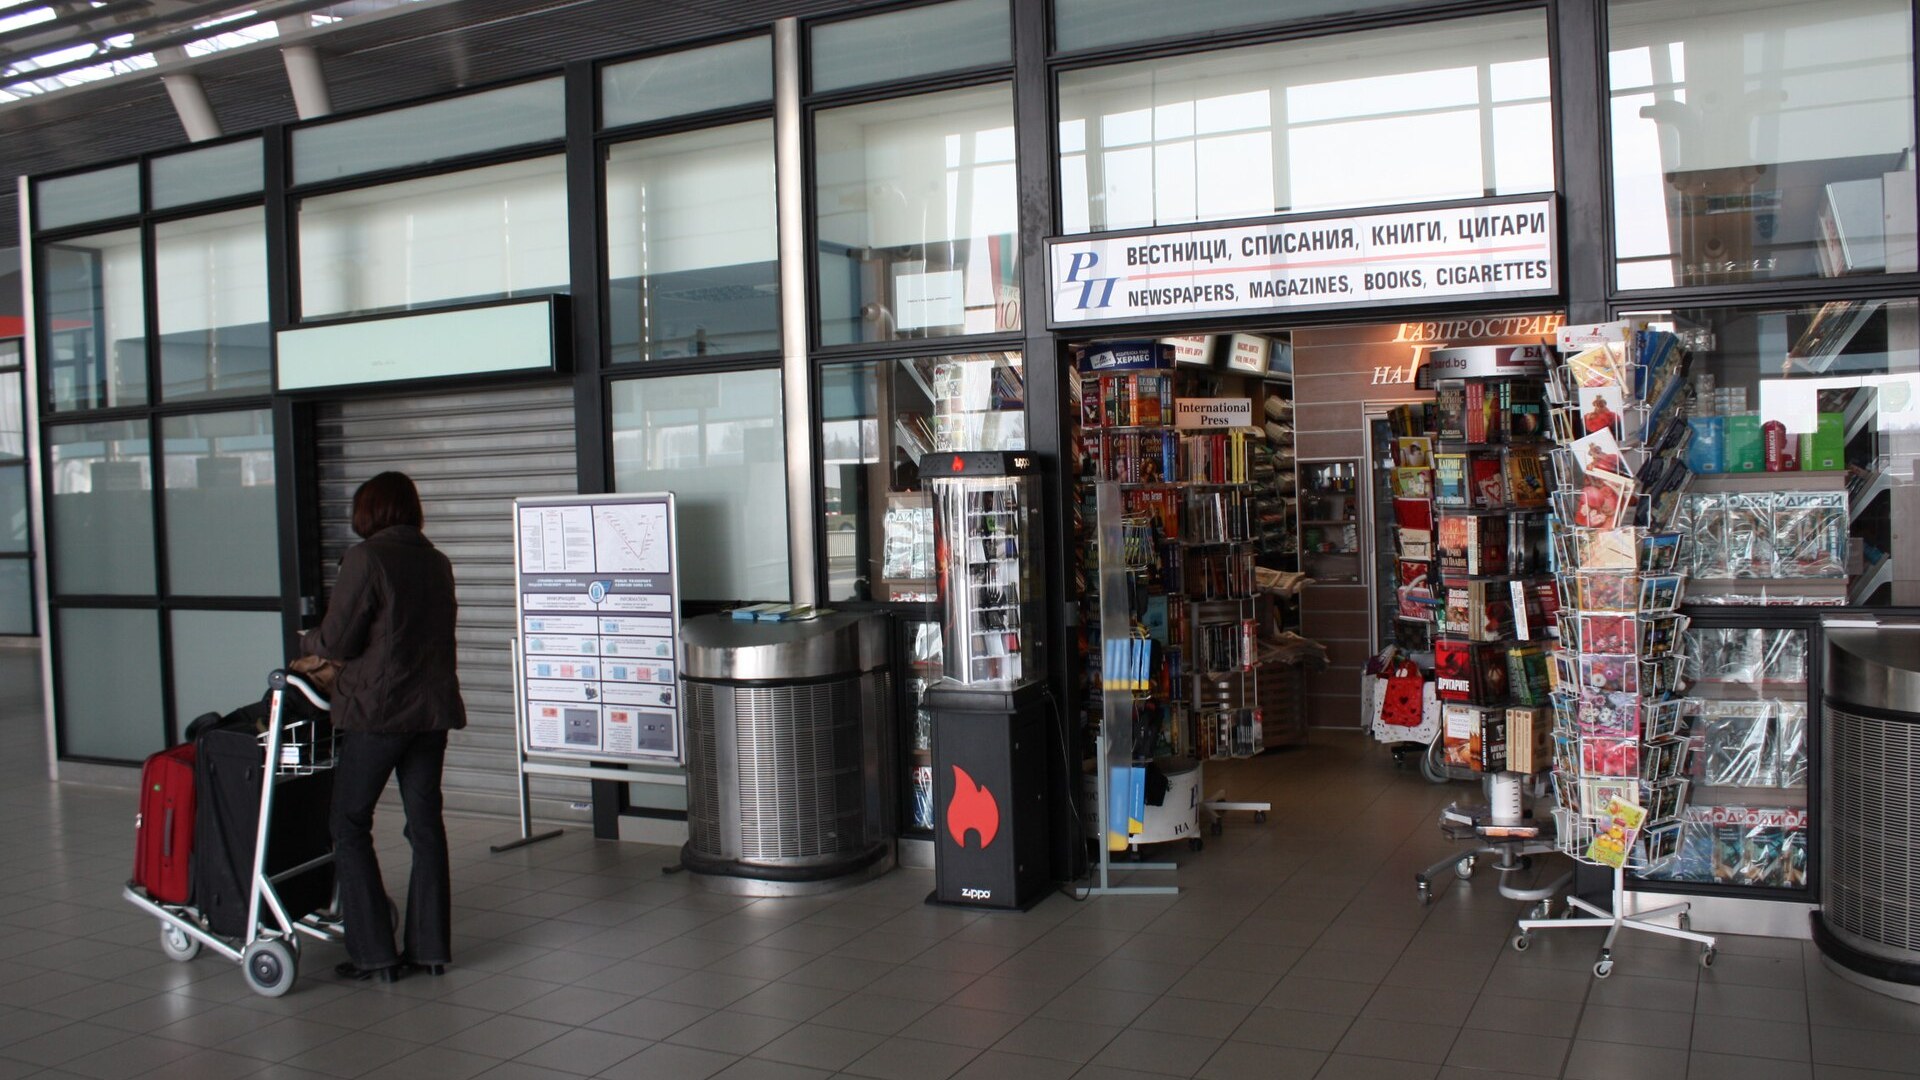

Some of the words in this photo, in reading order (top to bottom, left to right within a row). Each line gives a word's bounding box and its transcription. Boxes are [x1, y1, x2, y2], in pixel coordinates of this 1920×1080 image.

[1127, 240, 1233, 266] ВЕСТНИЦИ,
[1241, 228, 1361, 257] СПИСАНИЯ,
[1372, 220, 1448, 246] КНИГИ,
[1459, 212, 1545, 243] ЦИГАРИ
[1128, 283, 1240, 307] NEWSPAPERS,
[1249, 276, 1354, 300] MAGAZINES,
[1364, 269, 1428, 292] BOOKS,
[1436, 260, 1547, 286] CIGARETTES
[1116, 354, 1150, 364] ХЕРМЕС
[1178, 402, 1250, 413] International
[1200, 415, 1229, 425] Press
[961, 888, 991, 899] zippo
